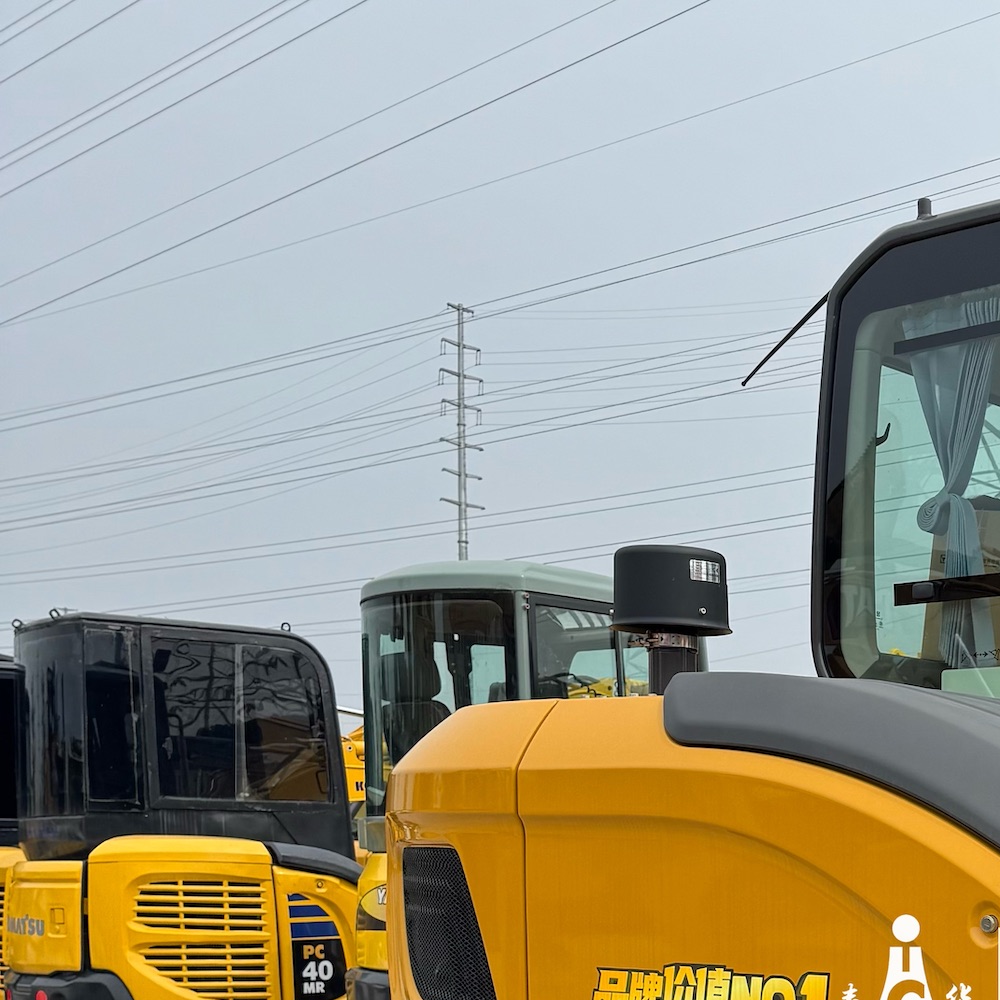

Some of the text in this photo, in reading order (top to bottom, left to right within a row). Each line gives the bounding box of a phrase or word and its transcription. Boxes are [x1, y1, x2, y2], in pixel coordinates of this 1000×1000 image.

[302, 944, 326, 960] PC
[302, 960, 334, 981] 40
[303, 981, 326, 995] MR
